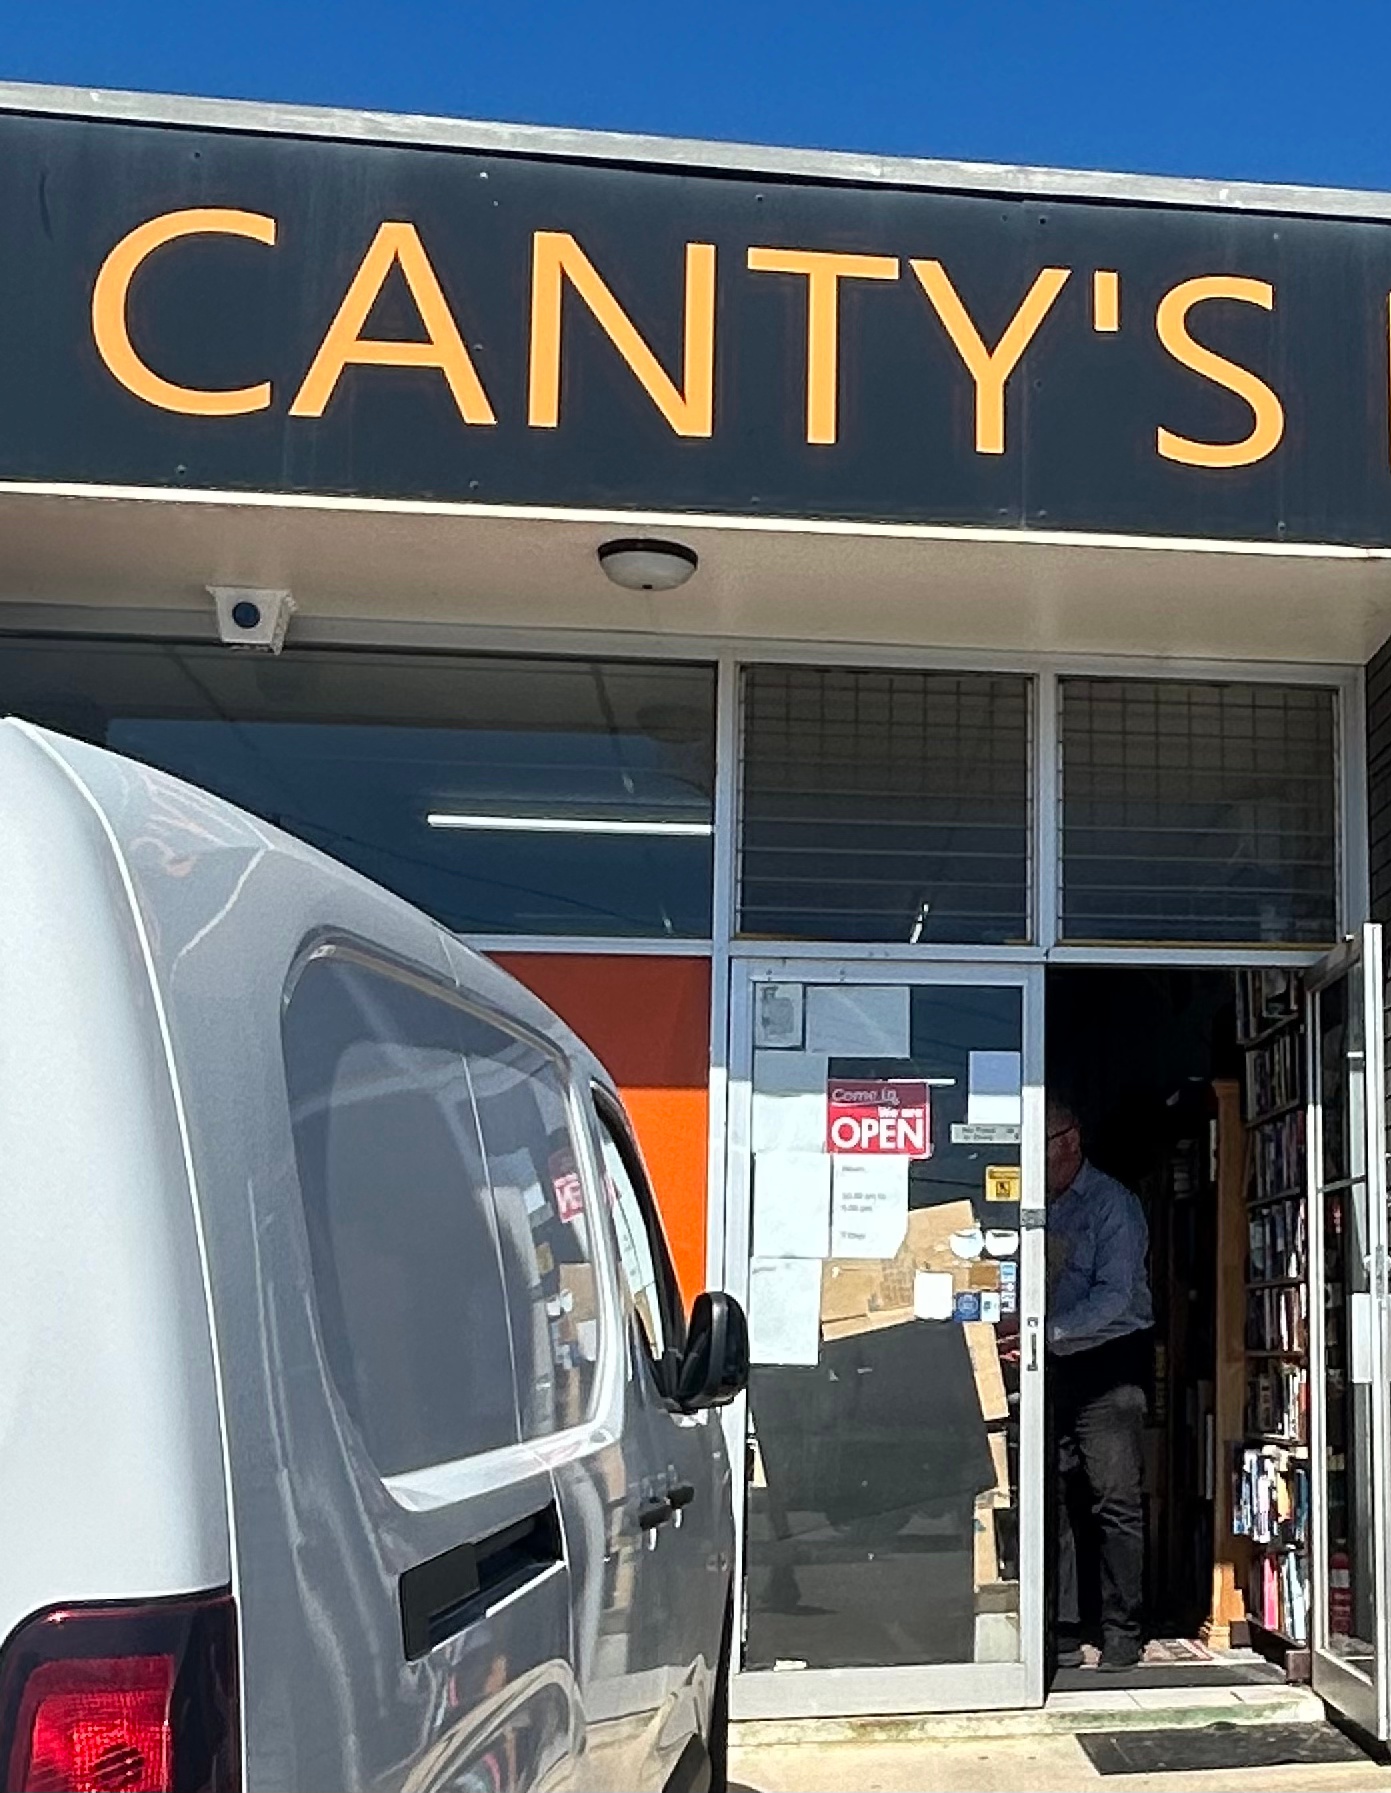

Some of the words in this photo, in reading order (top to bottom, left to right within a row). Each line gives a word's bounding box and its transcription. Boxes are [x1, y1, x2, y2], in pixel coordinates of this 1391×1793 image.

[91, 207, 1285, 468] CANTY'S
[832, 1088, 877, 1102] Come
[831, 1116, 923, 1149] OPEN
